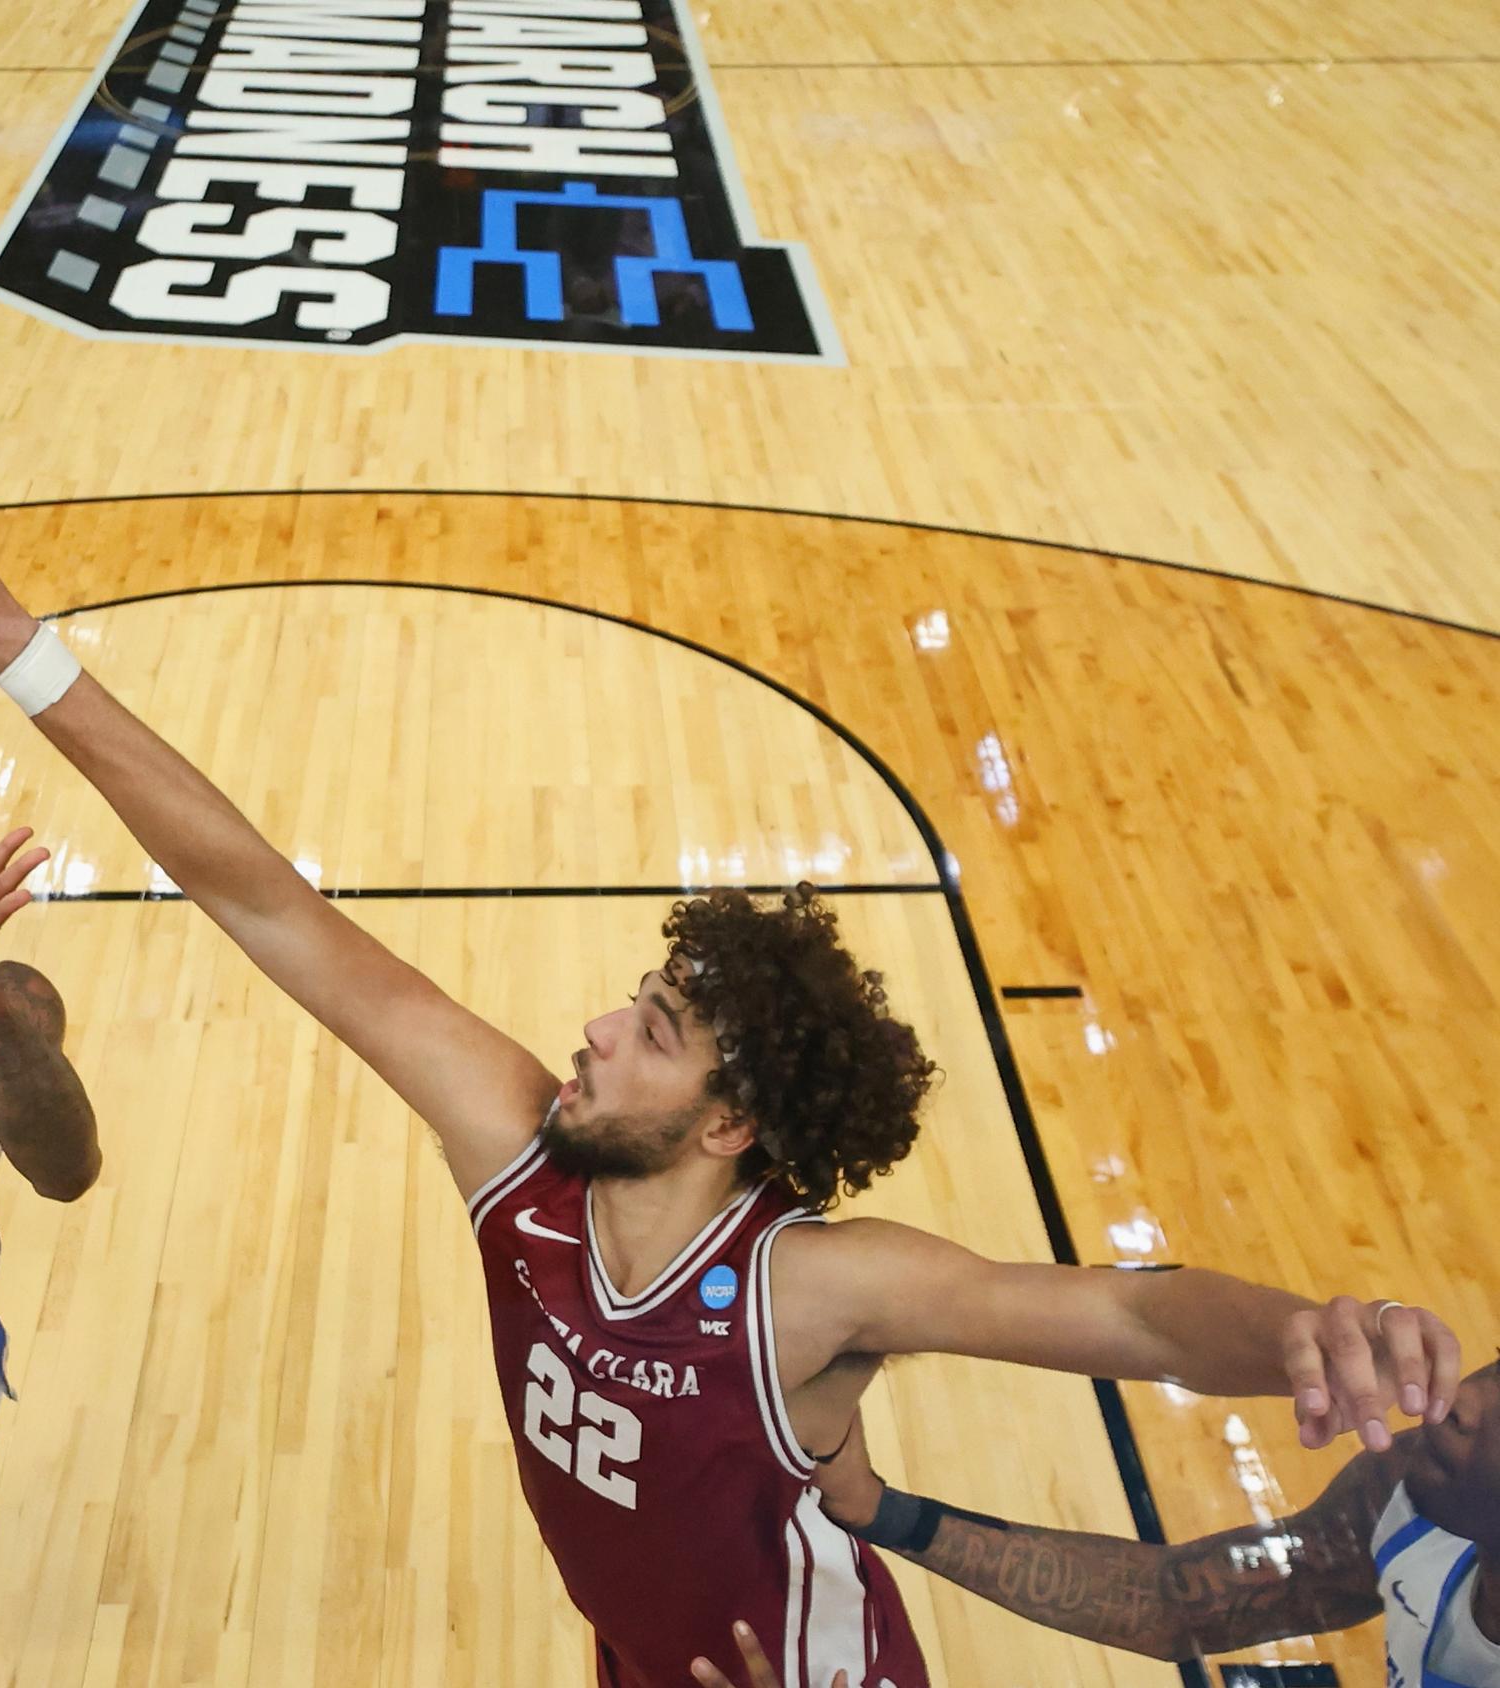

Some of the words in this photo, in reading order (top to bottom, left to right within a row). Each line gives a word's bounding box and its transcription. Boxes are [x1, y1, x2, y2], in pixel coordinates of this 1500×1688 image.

[109, 0, 426, 330] MADNESS
[524, 1342, 643, 1511] 22
[587, 1348, 701, 1399] CLARA
